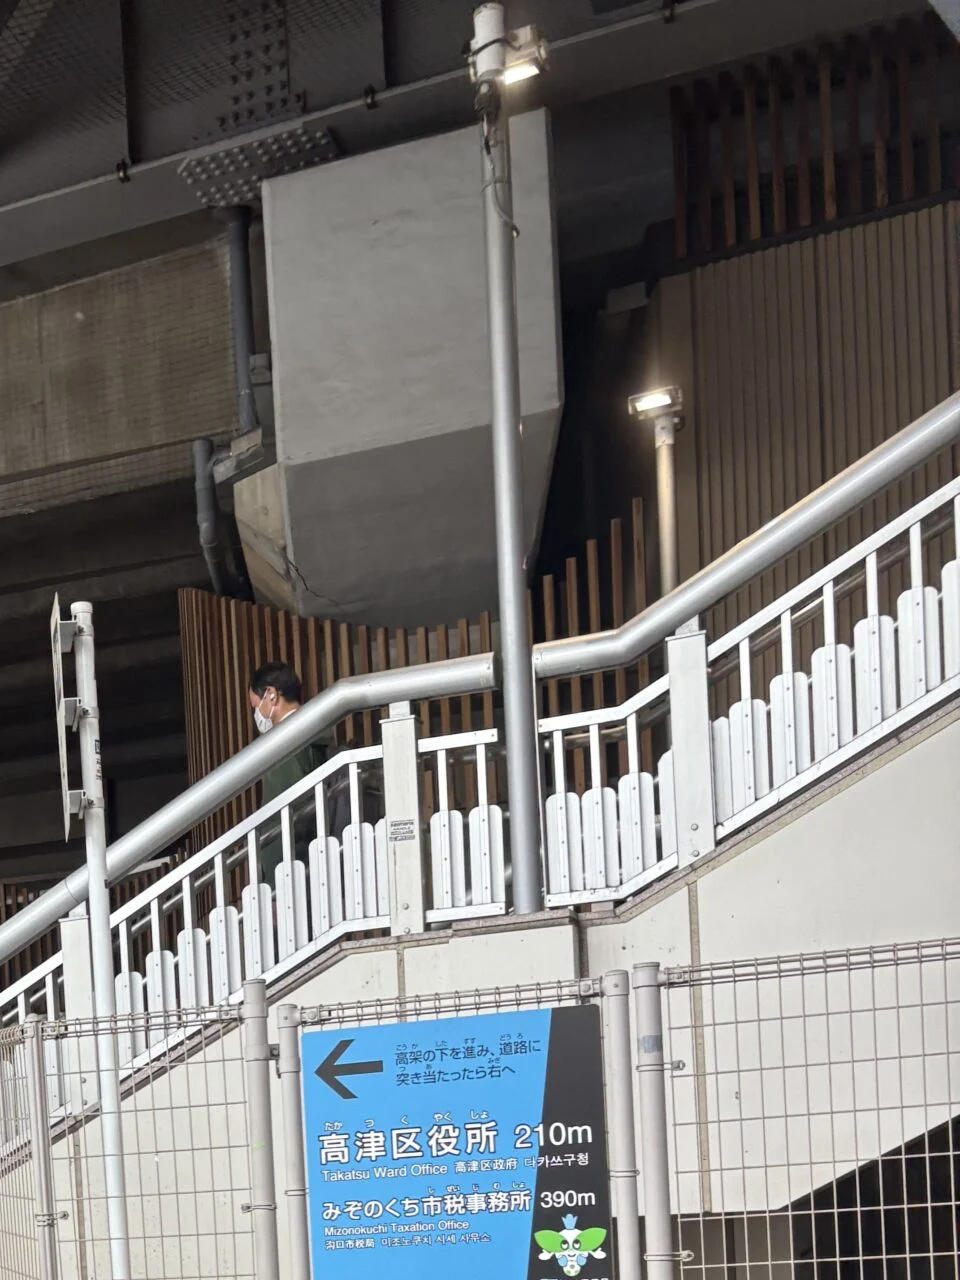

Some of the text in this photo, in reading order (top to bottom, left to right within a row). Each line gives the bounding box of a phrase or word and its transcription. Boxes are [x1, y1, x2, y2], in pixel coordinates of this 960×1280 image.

[395, 1039, 541, 1066] 高架の下を進み、道路に
[396, 1064, 516, 1086] 突き当たったら右へ
[318, 1120, 592, 1165] 高津区役所 210m
[455, 1158, 518, 1173] 高津区政府
[524, 1152, 589, 1168] 다카쓰구청
[322, 1163, 448, 1182] Takatsu Ward Office
[322, 1189, 596, 1220] みぞのくち市税事務所 390m
[324, 1220, 469, 1236] Mizonokuchi Taxation Office
